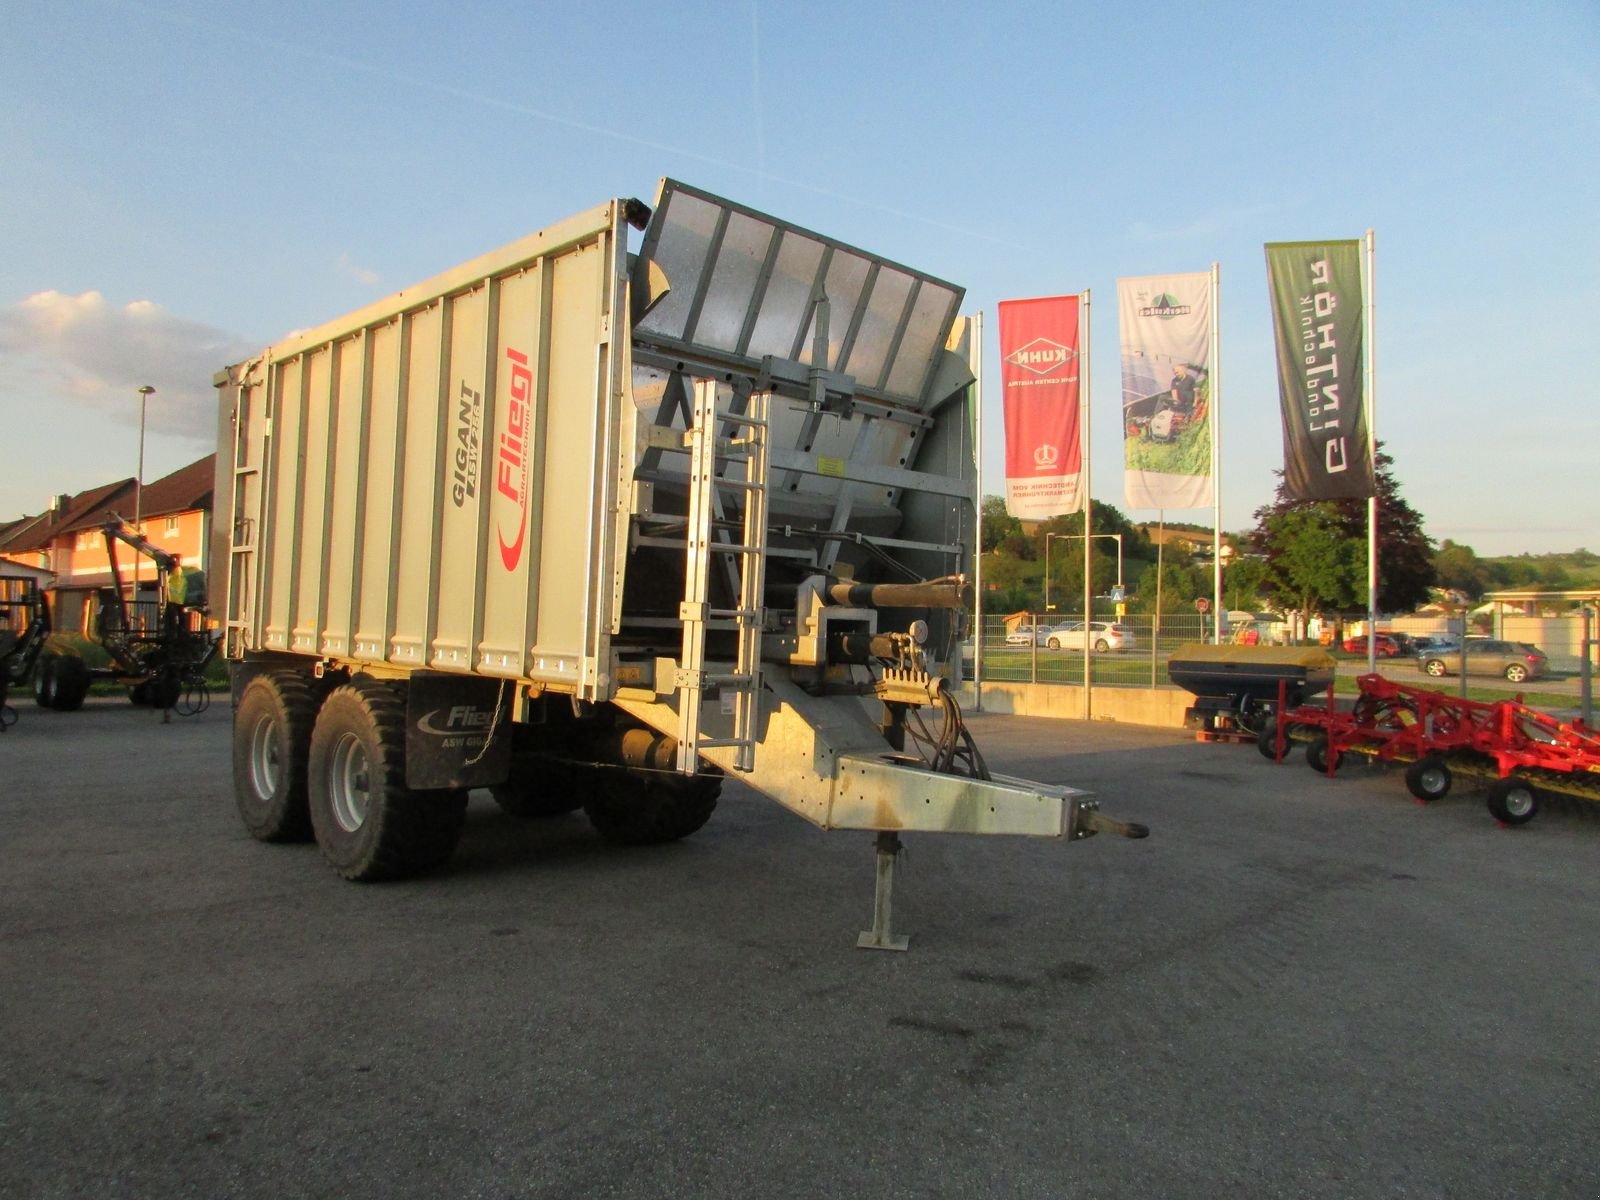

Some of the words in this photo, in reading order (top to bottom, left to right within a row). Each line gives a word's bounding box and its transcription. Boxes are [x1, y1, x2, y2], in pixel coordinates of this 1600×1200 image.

[452, 380, 473, 507] GIGANT
[467, 443, 478, 488] ASW
[498, 348, 532, 502] Fliegl
[519, 409, 531, 508] AGRARTECHNIK
[441, 738, 464, 748] ASW
